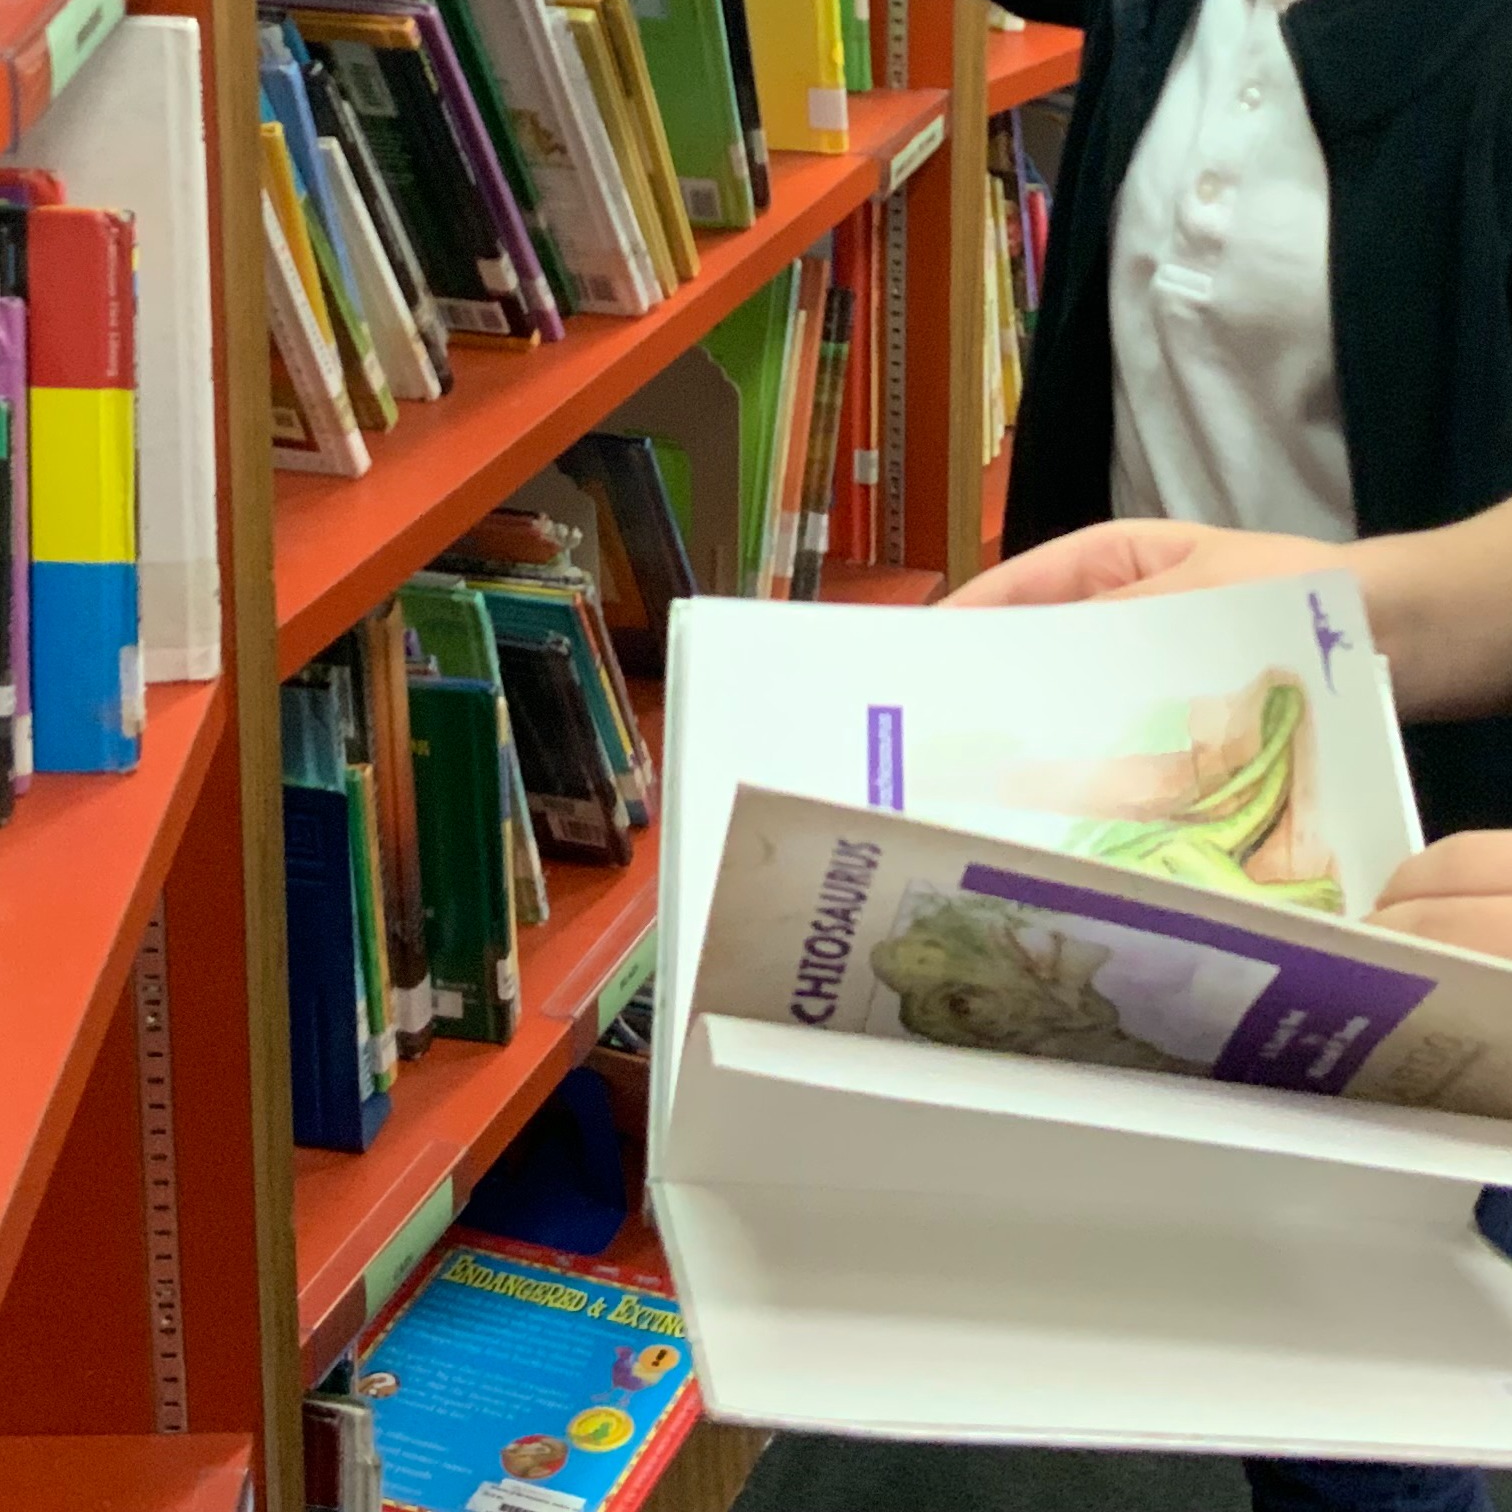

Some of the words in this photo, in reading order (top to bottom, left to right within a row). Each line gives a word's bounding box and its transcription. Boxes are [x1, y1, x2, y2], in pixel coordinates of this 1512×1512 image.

[790, 837, 883, 1026] CHIOSAURUS
[441, 1254, 588, 1312] ENDANGERED
[586, 1296, 607, 1319] &
